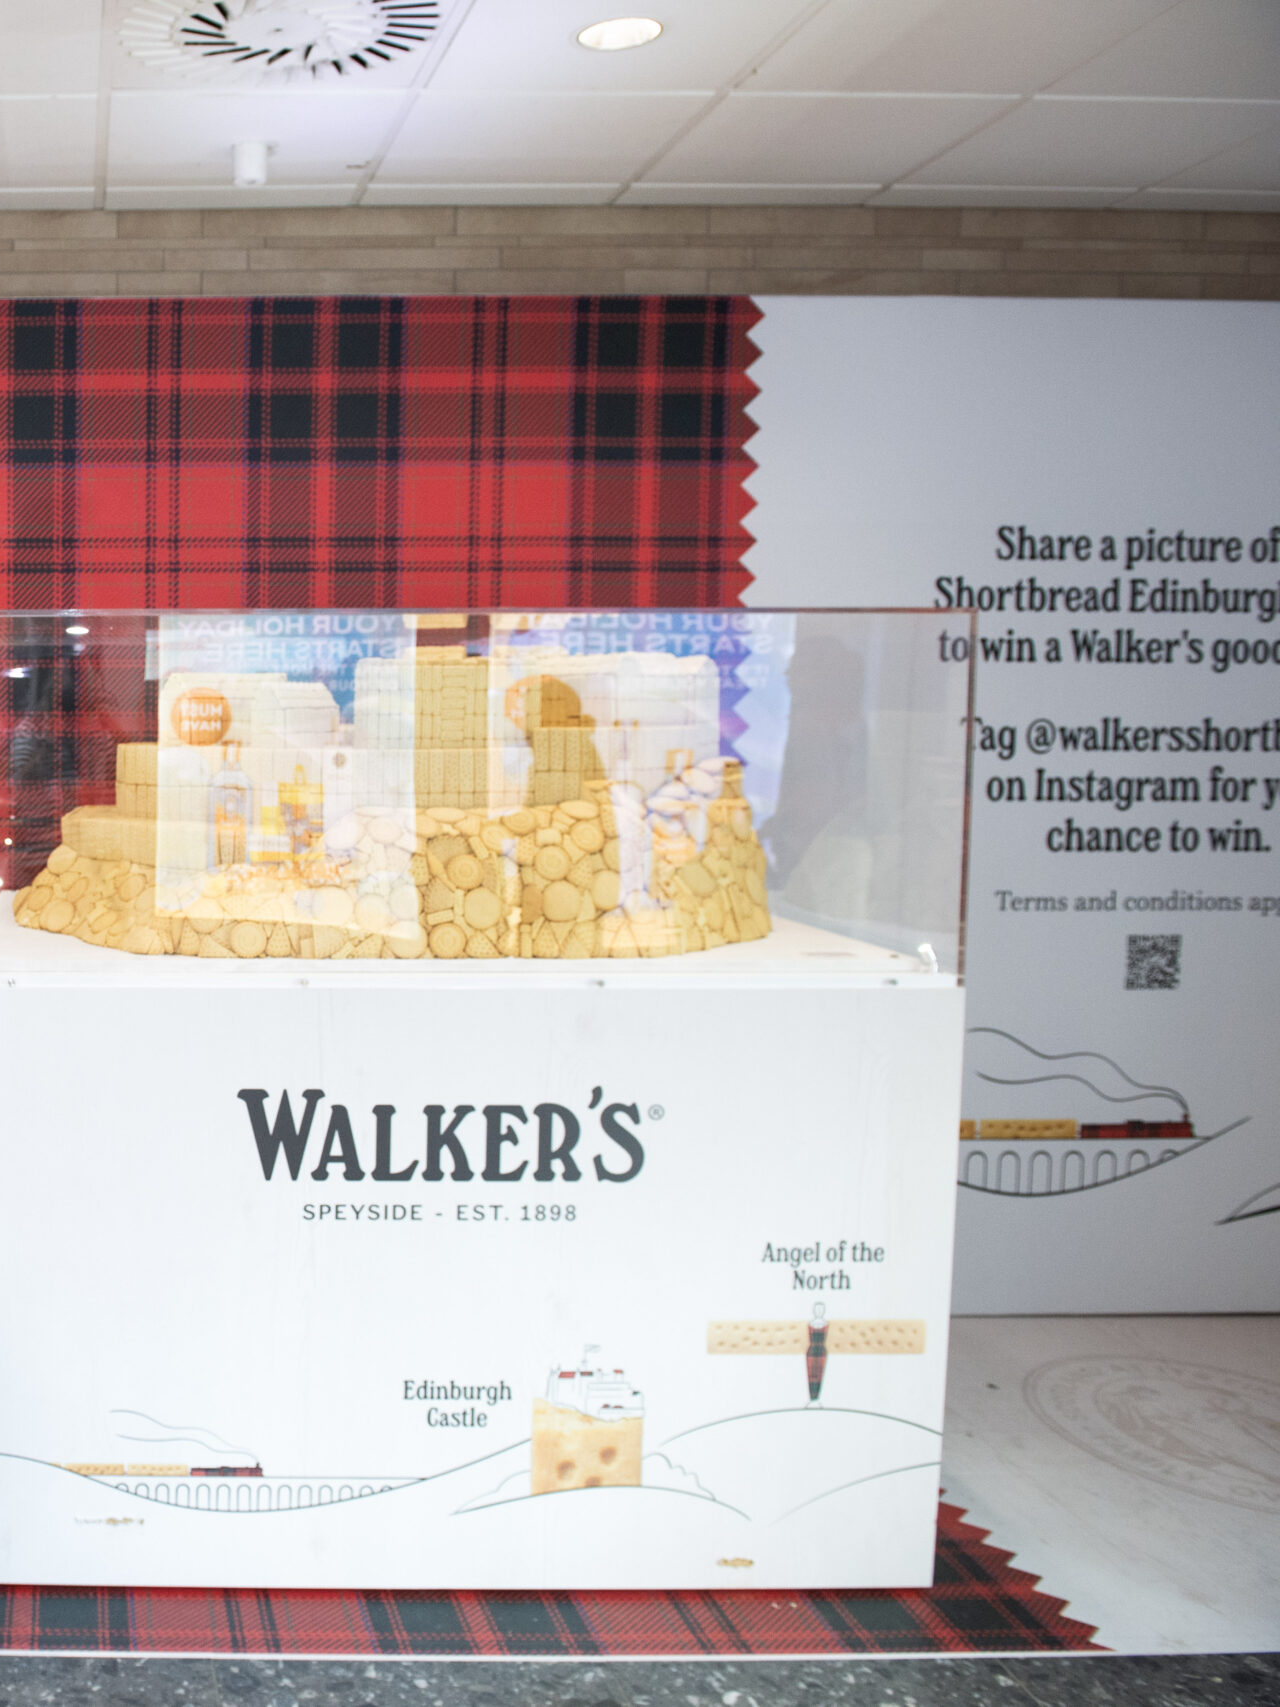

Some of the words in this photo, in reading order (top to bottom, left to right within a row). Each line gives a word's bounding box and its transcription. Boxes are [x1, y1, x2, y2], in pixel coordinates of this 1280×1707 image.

[995, 525, 1093, 561] Share
[1100, 535, 1117, 561] a
[1125, 527, 1243, 571] picture
[934, 575, 1121, 612] Shortbread
[1129, 577, 1280, 623] Edinburg
[939, 629, 969, 662] to
[980, 628, 1037, 662] win
[1045, 637, 1062, 662] a
[1071, 629, 1204, 664] Walker's
[986, 776, 1026, 802] on
[1035, 767, 1200, 811] Instagram
[1210, 765, 1257, 802] for
[1046, 818, 1162, 852] chance
[1169, 820, 1200, 852] to
[1208, 819, 1272, 852] win.
[994, 890, 1068, 912] Terms
[1073, 889, 1117, 912] and
[1124, 888, 1243, 912] conditions
[302, 1204, 424, 1222] SPEYSIDE
[456, 1204, 510, 1221] EST.
[521, 1204, 578, 1222] 1898
[761, 1241, 821, 1268] Angel
[825, 1241, 847, 1264] of
[851, 1242, 885, 1264] the
[792, 1269, 851, 1291] North
[402, 1379, 513, 1404] Edinburgh
[426, 1407, 488, 1429] Castle
